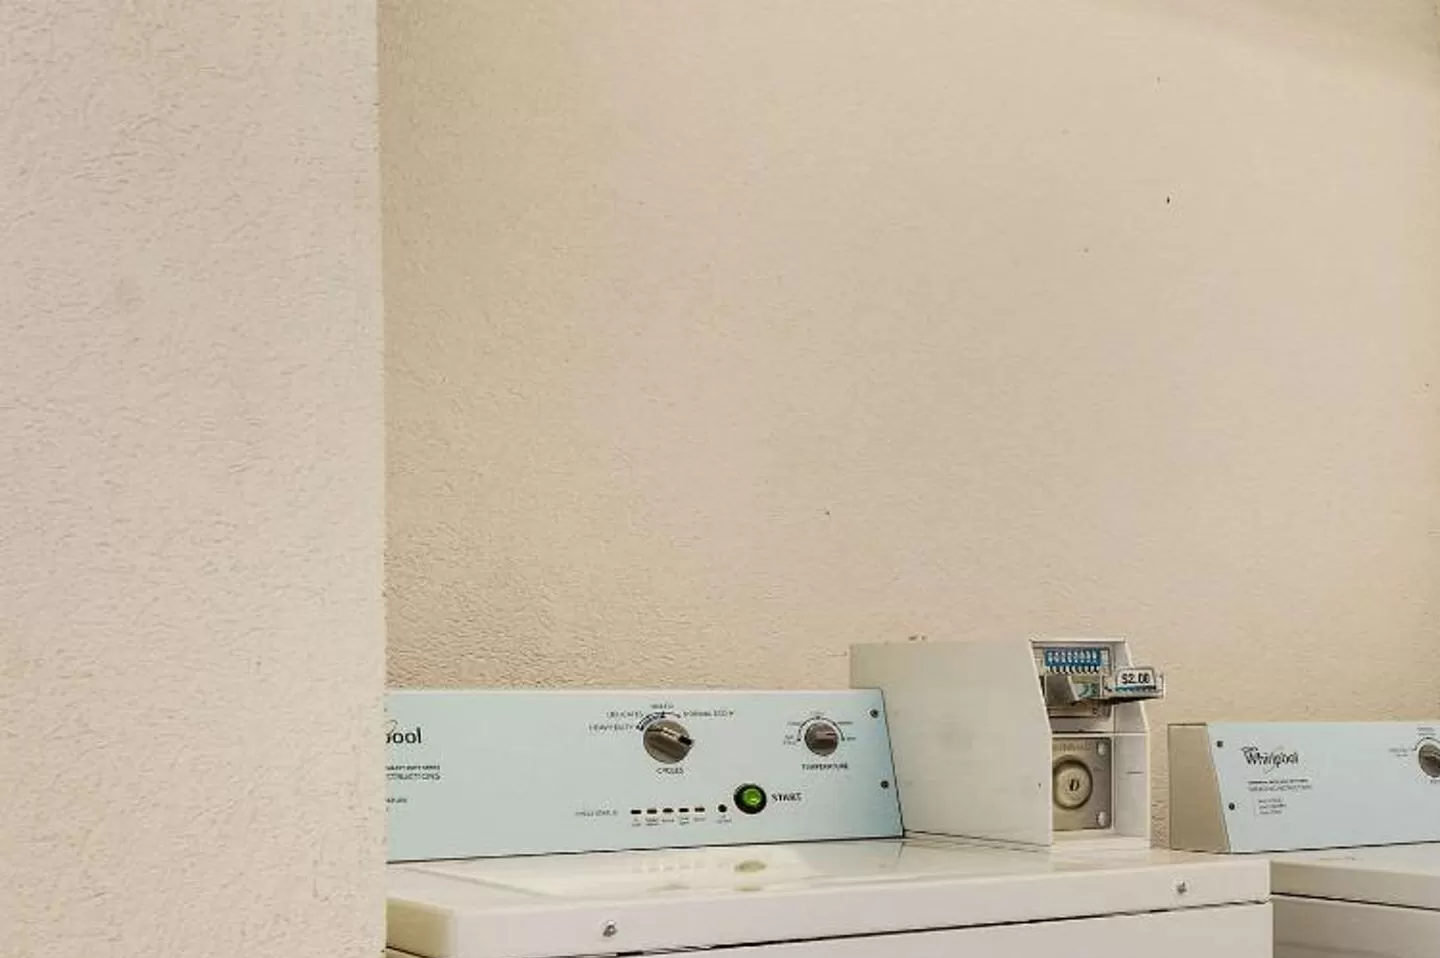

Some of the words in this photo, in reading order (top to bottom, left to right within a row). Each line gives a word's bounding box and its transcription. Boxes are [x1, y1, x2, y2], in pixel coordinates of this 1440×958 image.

[1121, 673, 1151, 685] $2.00
[1241, 746, 1299, 770] Whirlpool
[656, 767, 684, 775] CYCLES
[771, 793, 802, 802] START
